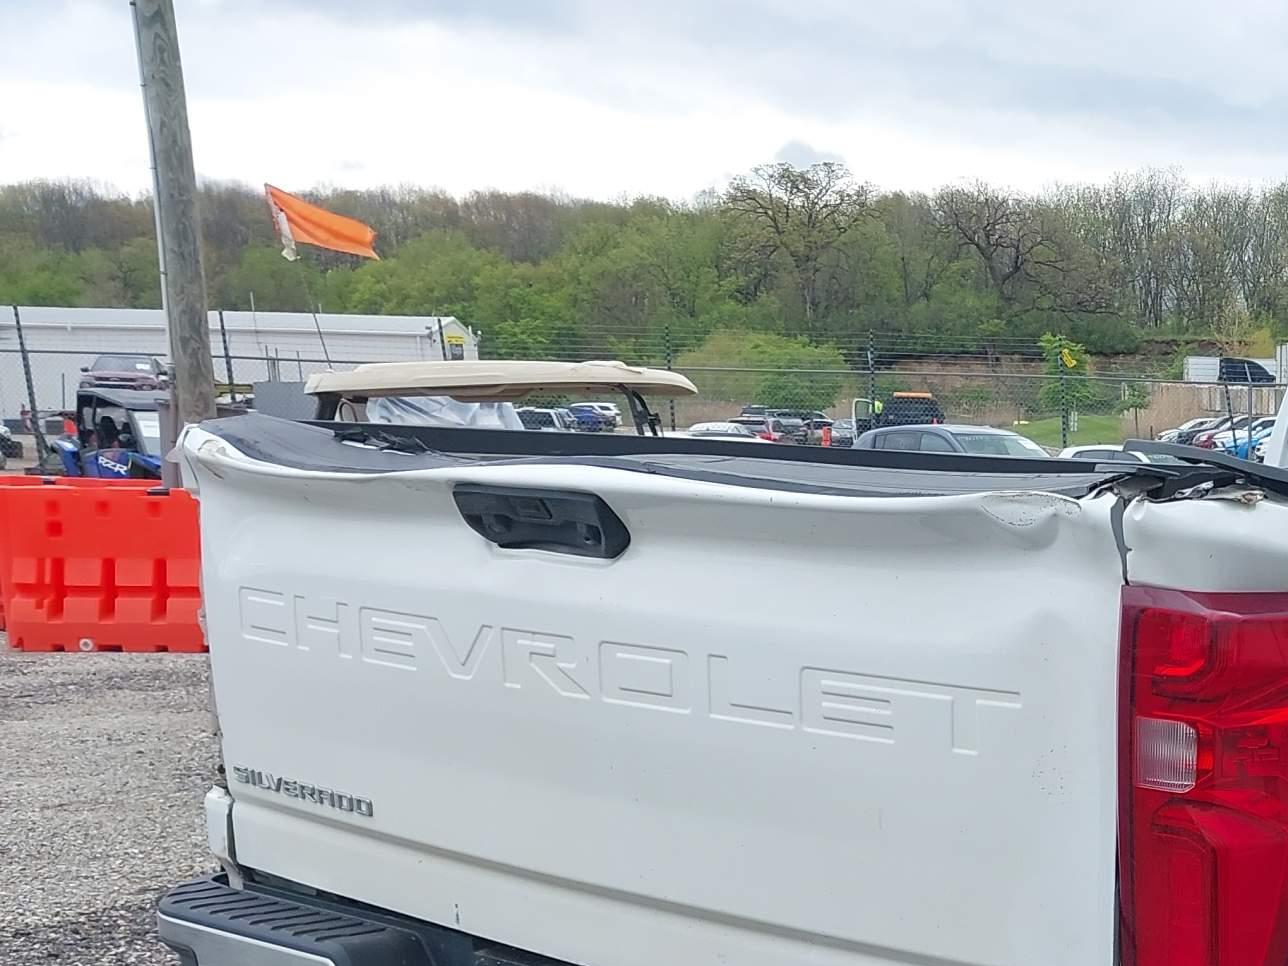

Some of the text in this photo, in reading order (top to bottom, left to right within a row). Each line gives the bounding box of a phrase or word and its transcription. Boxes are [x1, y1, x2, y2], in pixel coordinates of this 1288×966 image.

[98, 456, 128, 475] RZR
[238, 586, 1022, 755] CHEVROLET
[232, 765, 374, 817] SILVERADO
